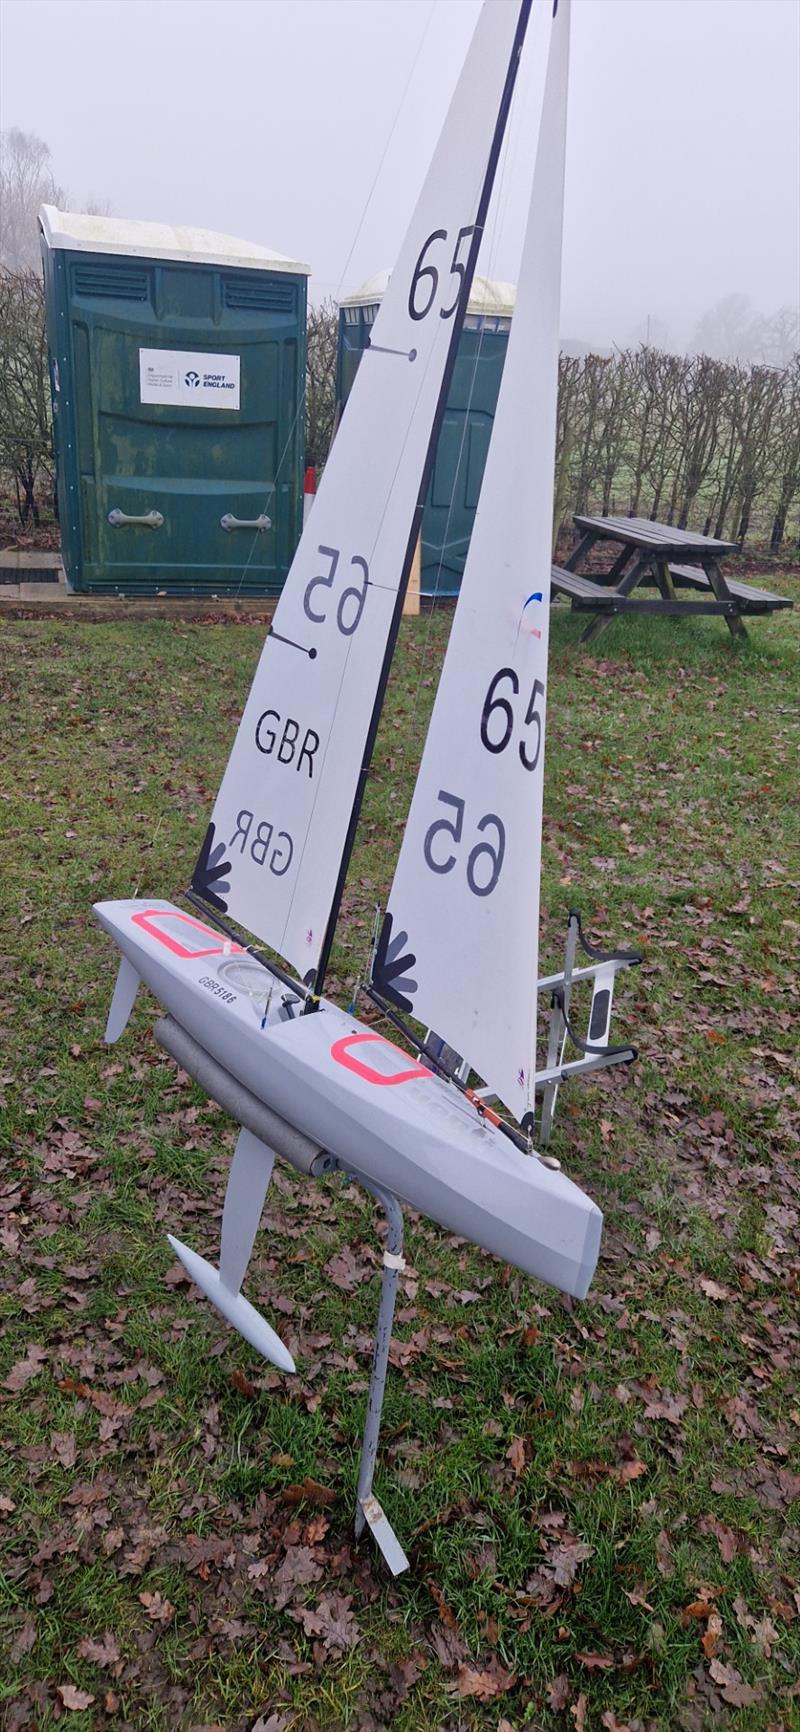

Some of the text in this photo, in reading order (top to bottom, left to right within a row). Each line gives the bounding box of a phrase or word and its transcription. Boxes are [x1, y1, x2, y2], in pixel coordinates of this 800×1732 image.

[408, 225, 475, 321] 65
[203, 381, 235, 389] ENGLAND
[255, 709, 320, 778] GBR
[480, 667, 545, 772] 65
[198, 976, 238, 1004] GBR5186
